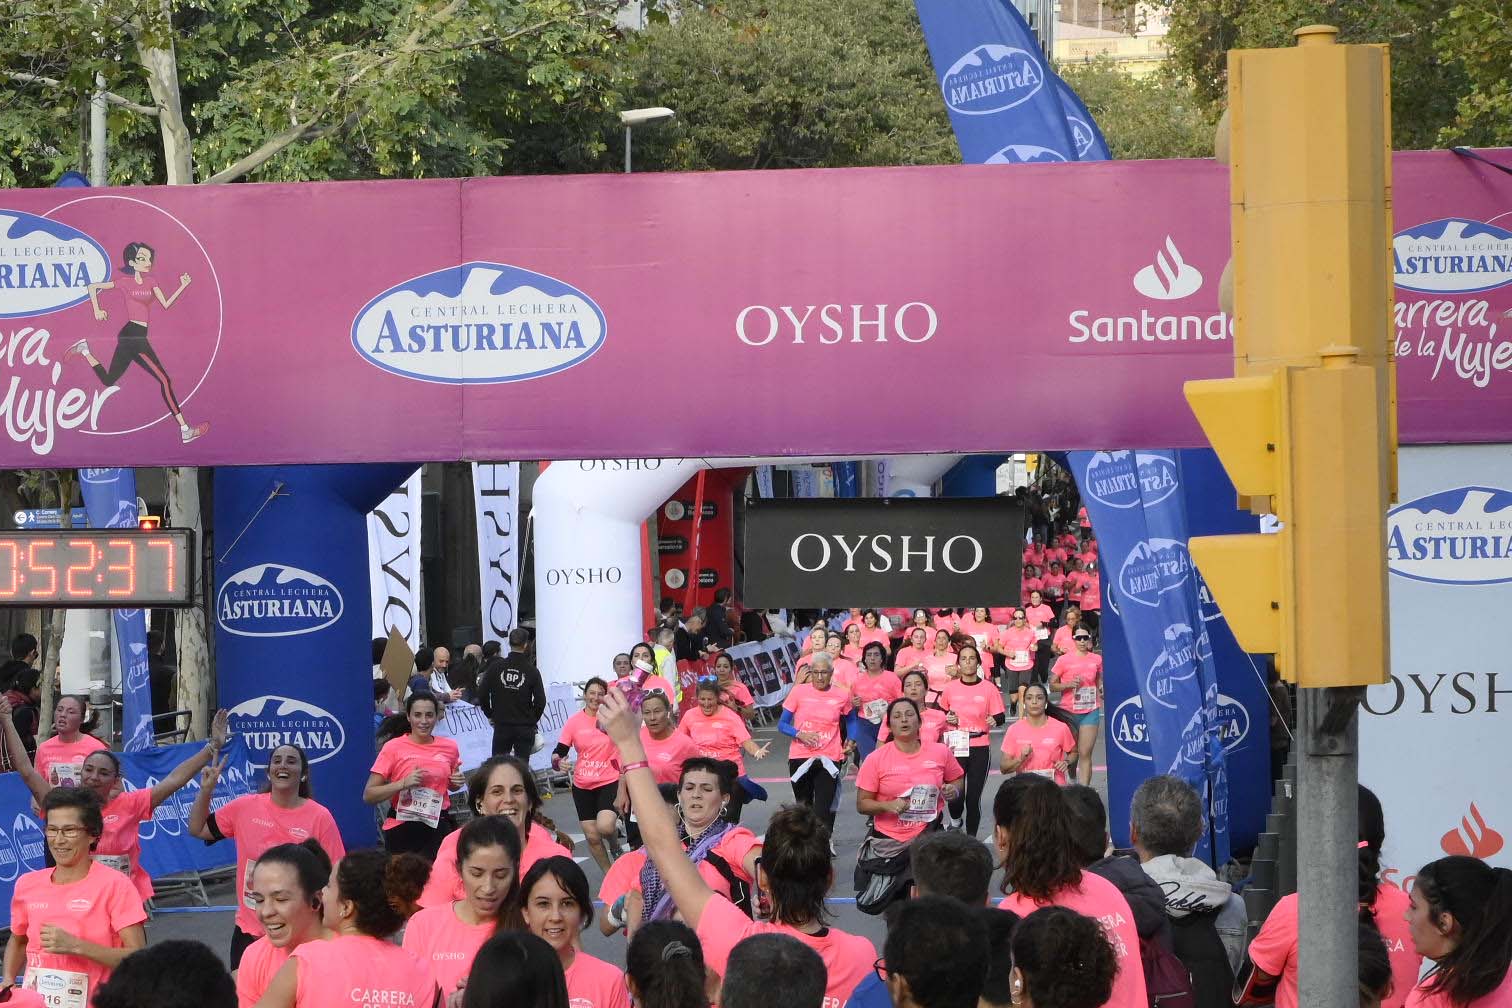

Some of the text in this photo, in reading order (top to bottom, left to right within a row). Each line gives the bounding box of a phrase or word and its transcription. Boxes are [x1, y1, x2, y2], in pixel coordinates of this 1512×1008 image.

[14, 246, 86, 257] LECHERA
[1464, 243, 1512, 252] LECHER
[411, 303, 578, 318] CENTRAL LECHERA
[1394, 299, 1489, 328] arrera
[372, 310, 587, 354] ASTURIANA
[735, 302, 938, 346] OYSHO
[1069, 309, 1232, 343] Santand
[1417, 328, 1436, 356] la
[1431, 322, 1512, 388] Muje
[1414, 520, 1482, 532] CENTRAL
[790, 533, 983, 574] OYSHO
[546, 566, 623, 586] OYSHO
[233, 588, 330, 598] CENTRAL LECHERA
[221, 593, 334, 621] ASTURIANA
[506, 673, 519, 682] BP
[1359, 671, 1512, 716] OYSH
[236, 719, 330, 729] CENTRAL LECHERA
[432, 952, 465, 961] OYSHO
[351, 988, 415, 1007] CARRERA
